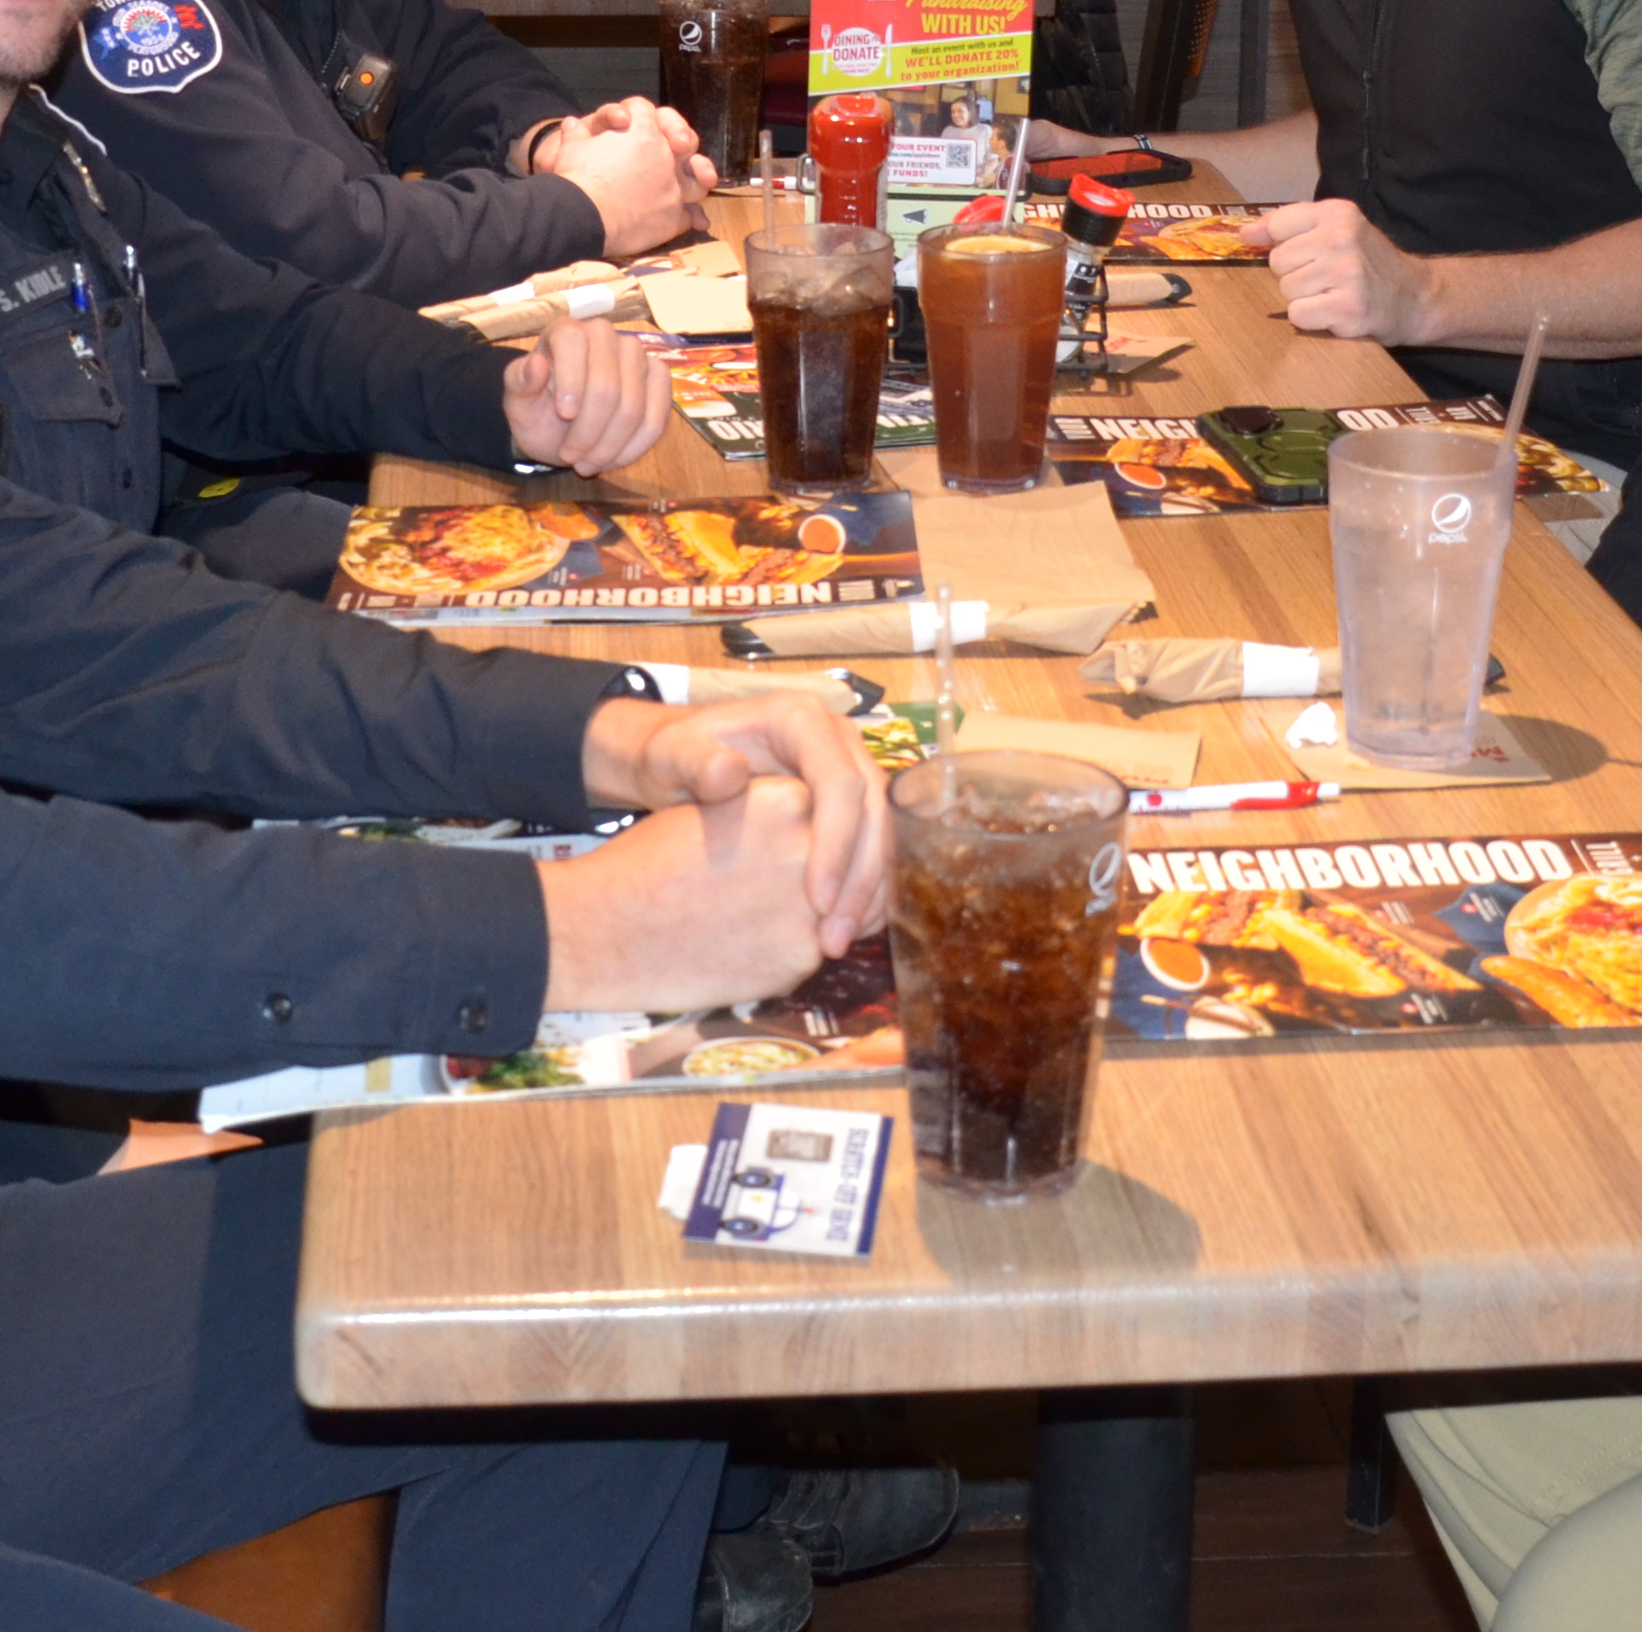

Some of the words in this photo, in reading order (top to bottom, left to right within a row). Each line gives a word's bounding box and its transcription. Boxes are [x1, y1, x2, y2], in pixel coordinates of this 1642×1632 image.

[921, 13, 972, 35] WITH
[975, 14, 1007, 35] US!
[834, 34, 872, 47] DINING
[911, 45, 930, 55] Host
[932, 46, 942, 54] an
[943, 44, 966, 53] event
[967, 41, 984, 51] with
[985, 41, 997, 49] us
[999, 37, 1014, 47] and
[126, 41, 201, 78] POLICE
[833, 46, 880, 62] DONATE
[905, 54, 942, 69] WE'LL
[945, 50, 993, 64] DONATE
[995, 48, 1020, 60] 20%
[901, 72, 913, 82] to
[915, 70, 942, 82] your
[944, 62, 1021, 80] organization!
[917, 144, 946, 152] EVENT
[465, 582, 832, 608] NEIGHBORHOOD
[1126, 839, 1574, 895] NEIGHBORHOOD
